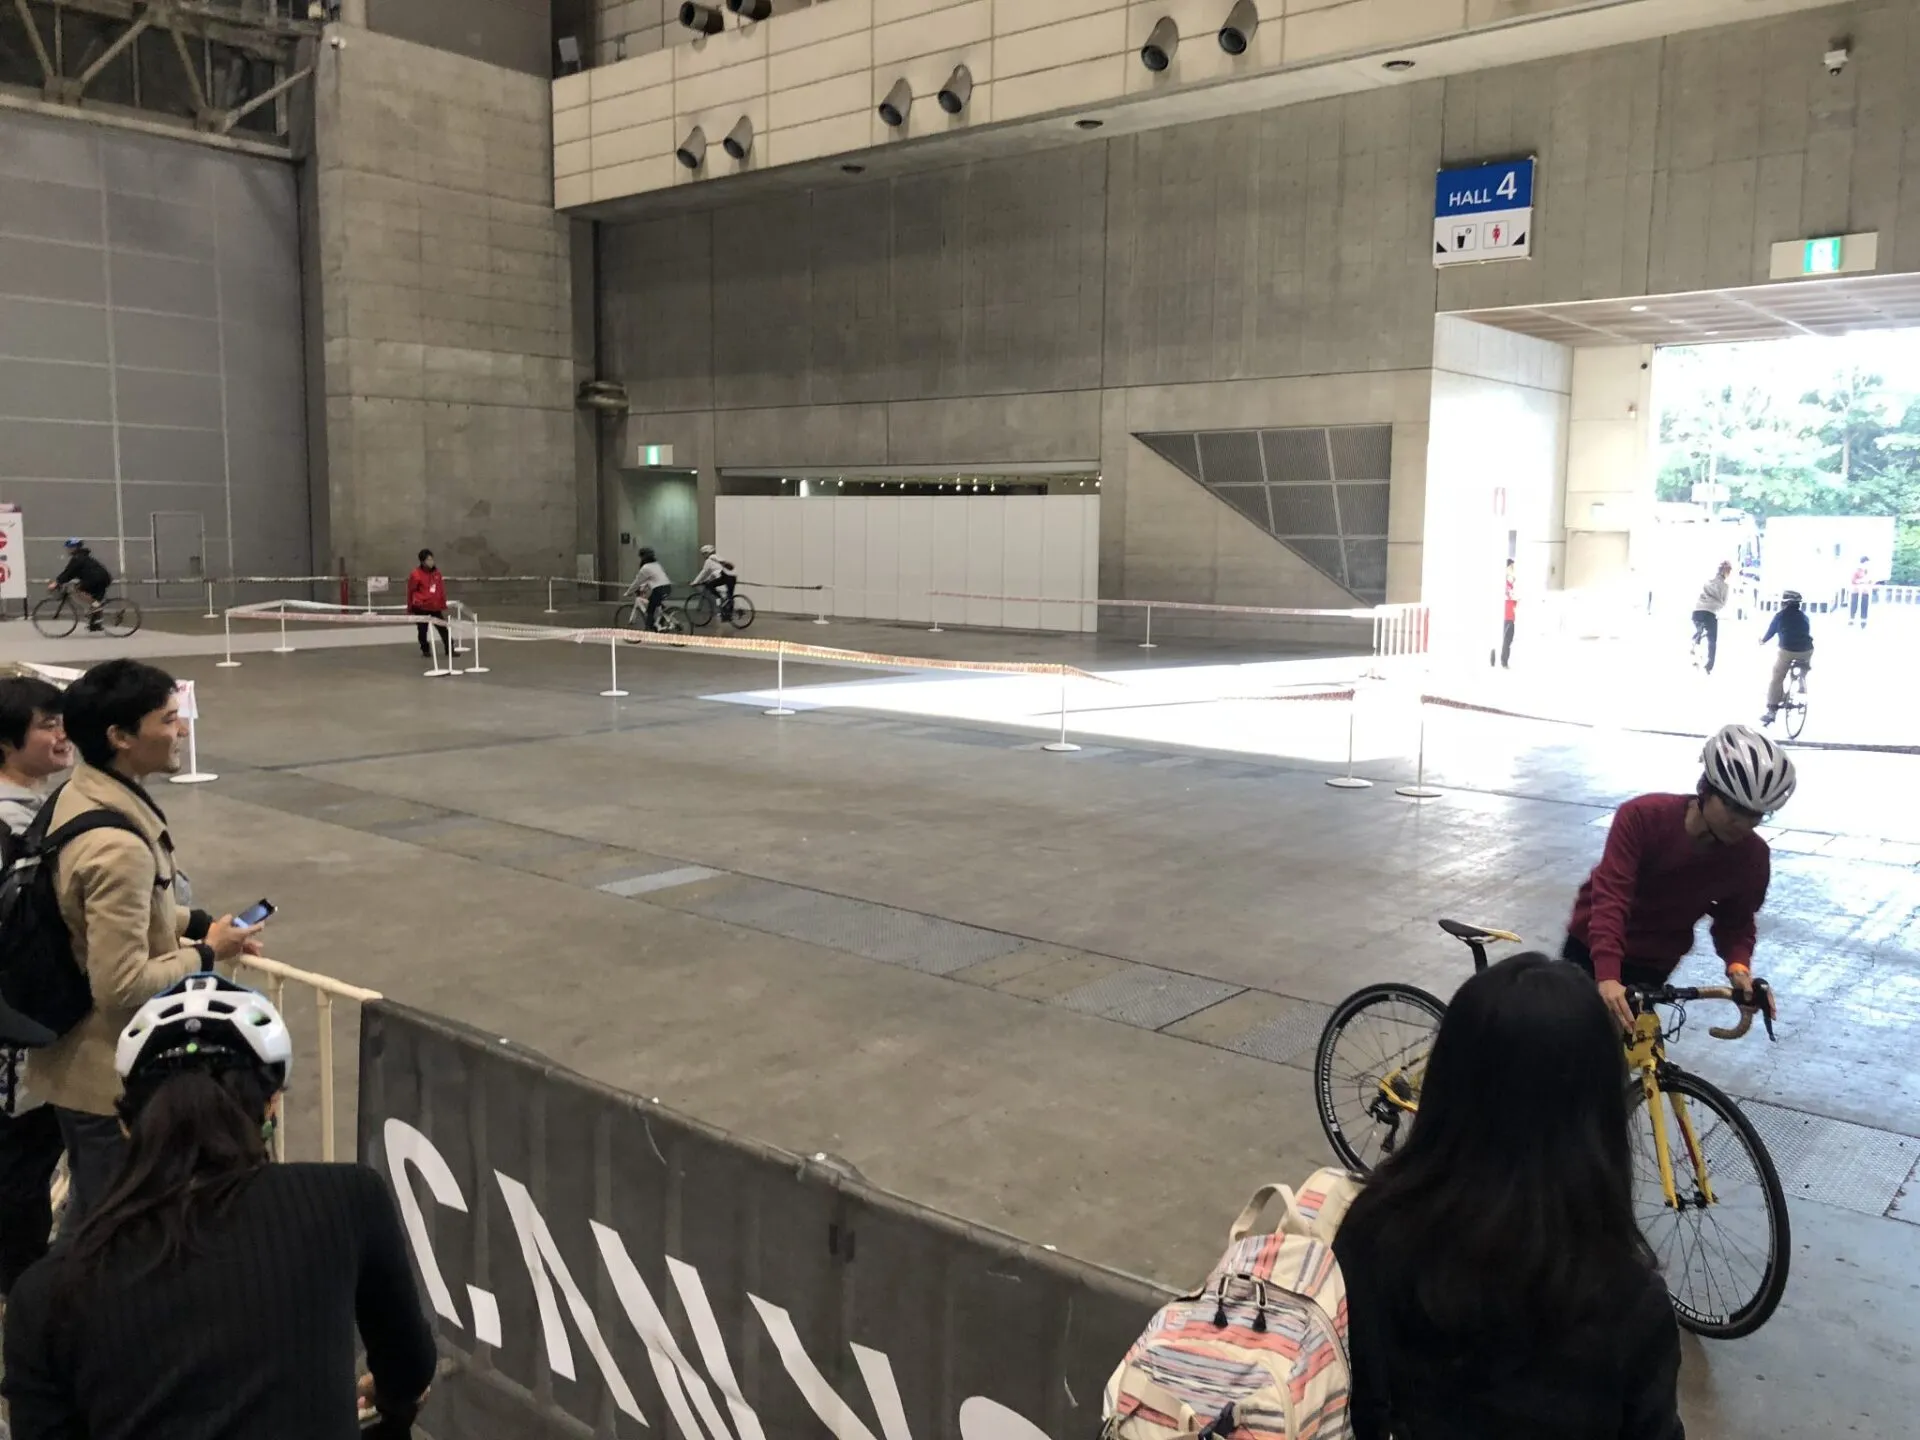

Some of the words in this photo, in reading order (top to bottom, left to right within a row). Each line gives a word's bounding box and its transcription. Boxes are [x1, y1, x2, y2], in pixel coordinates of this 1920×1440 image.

[1449, 188, 1491, 207] HALL
[1496, 171, 1517, 200] 4
[384, 1118, 1055, 1440] CANN
